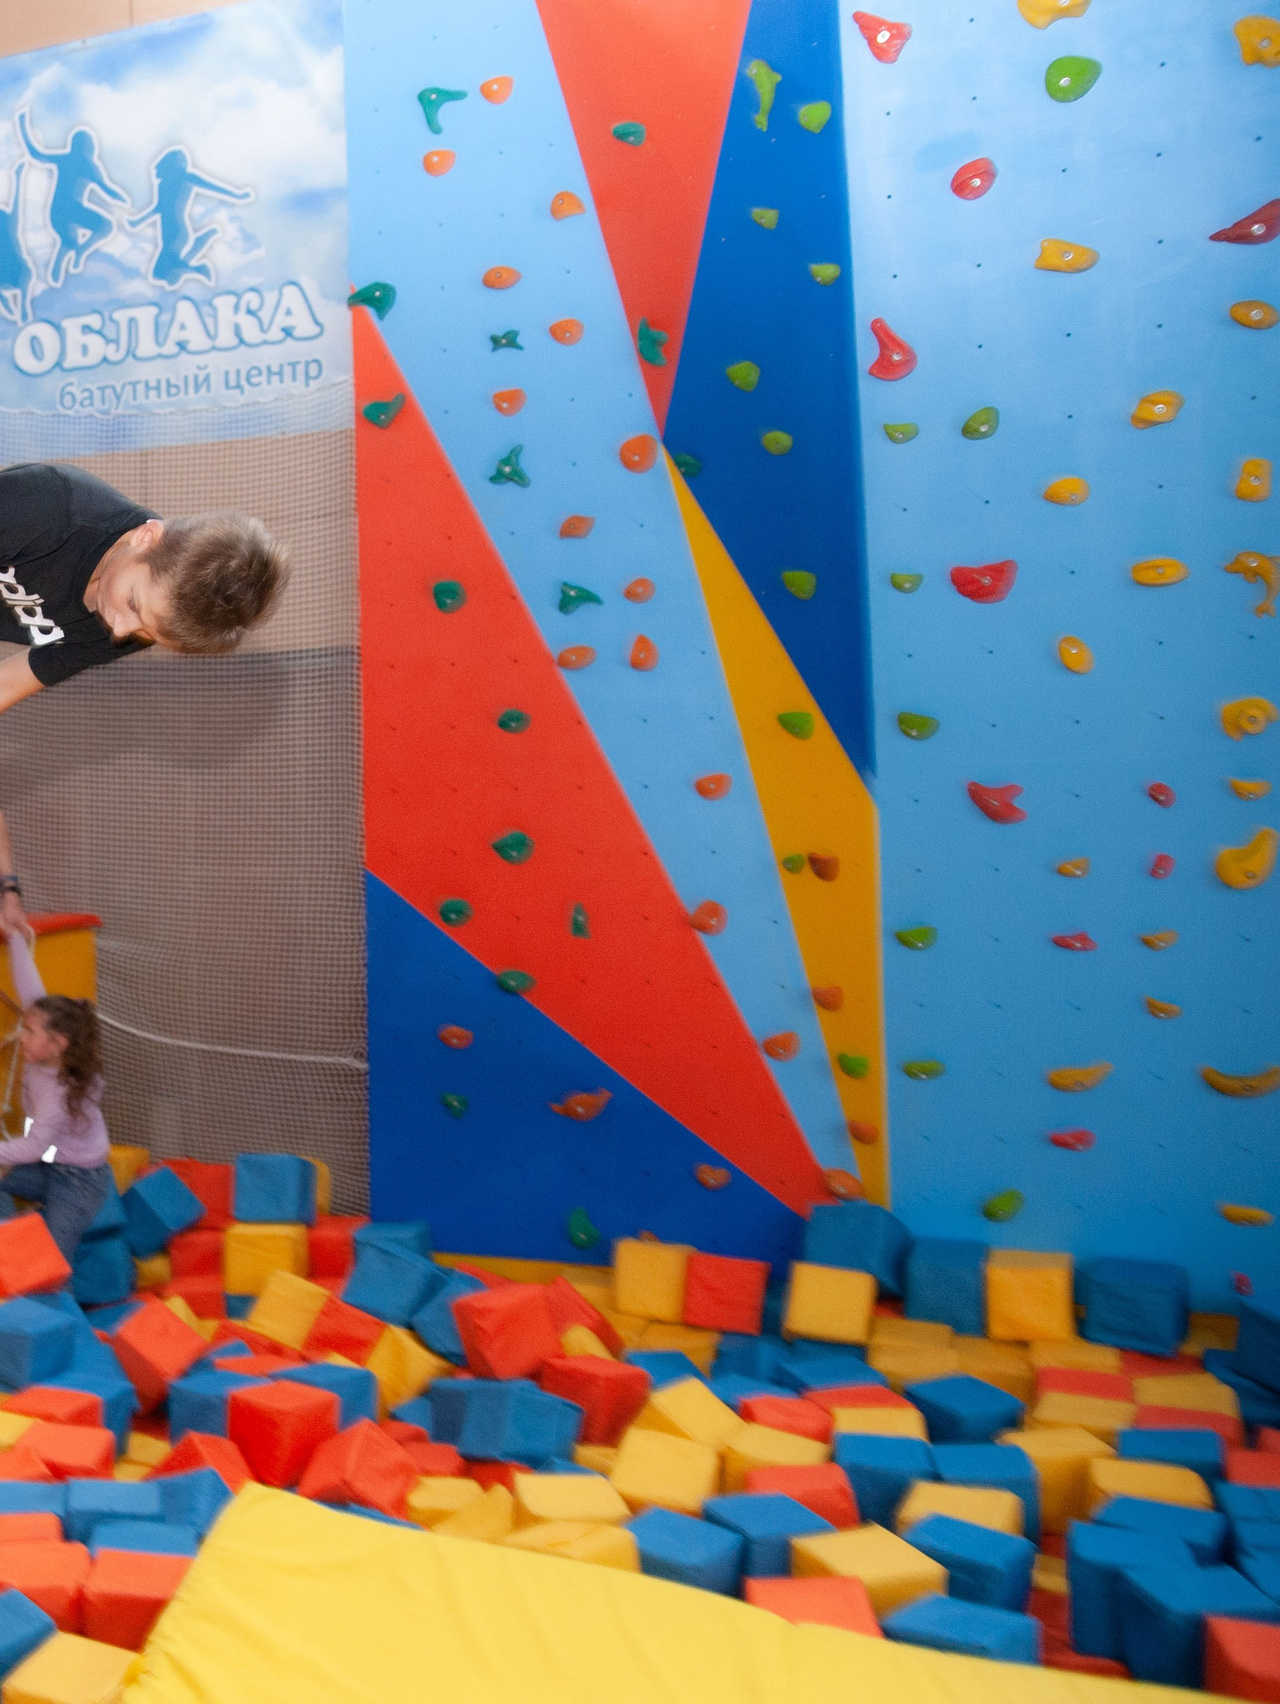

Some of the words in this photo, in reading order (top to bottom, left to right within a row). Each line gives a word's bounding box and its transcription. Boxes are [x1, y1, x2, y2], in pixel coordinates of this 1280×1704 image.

[13, 281, 324, 376] ОБЛАКА
[59, 364, 211, 411] батутный
[223, 358, 324, 396] центр
